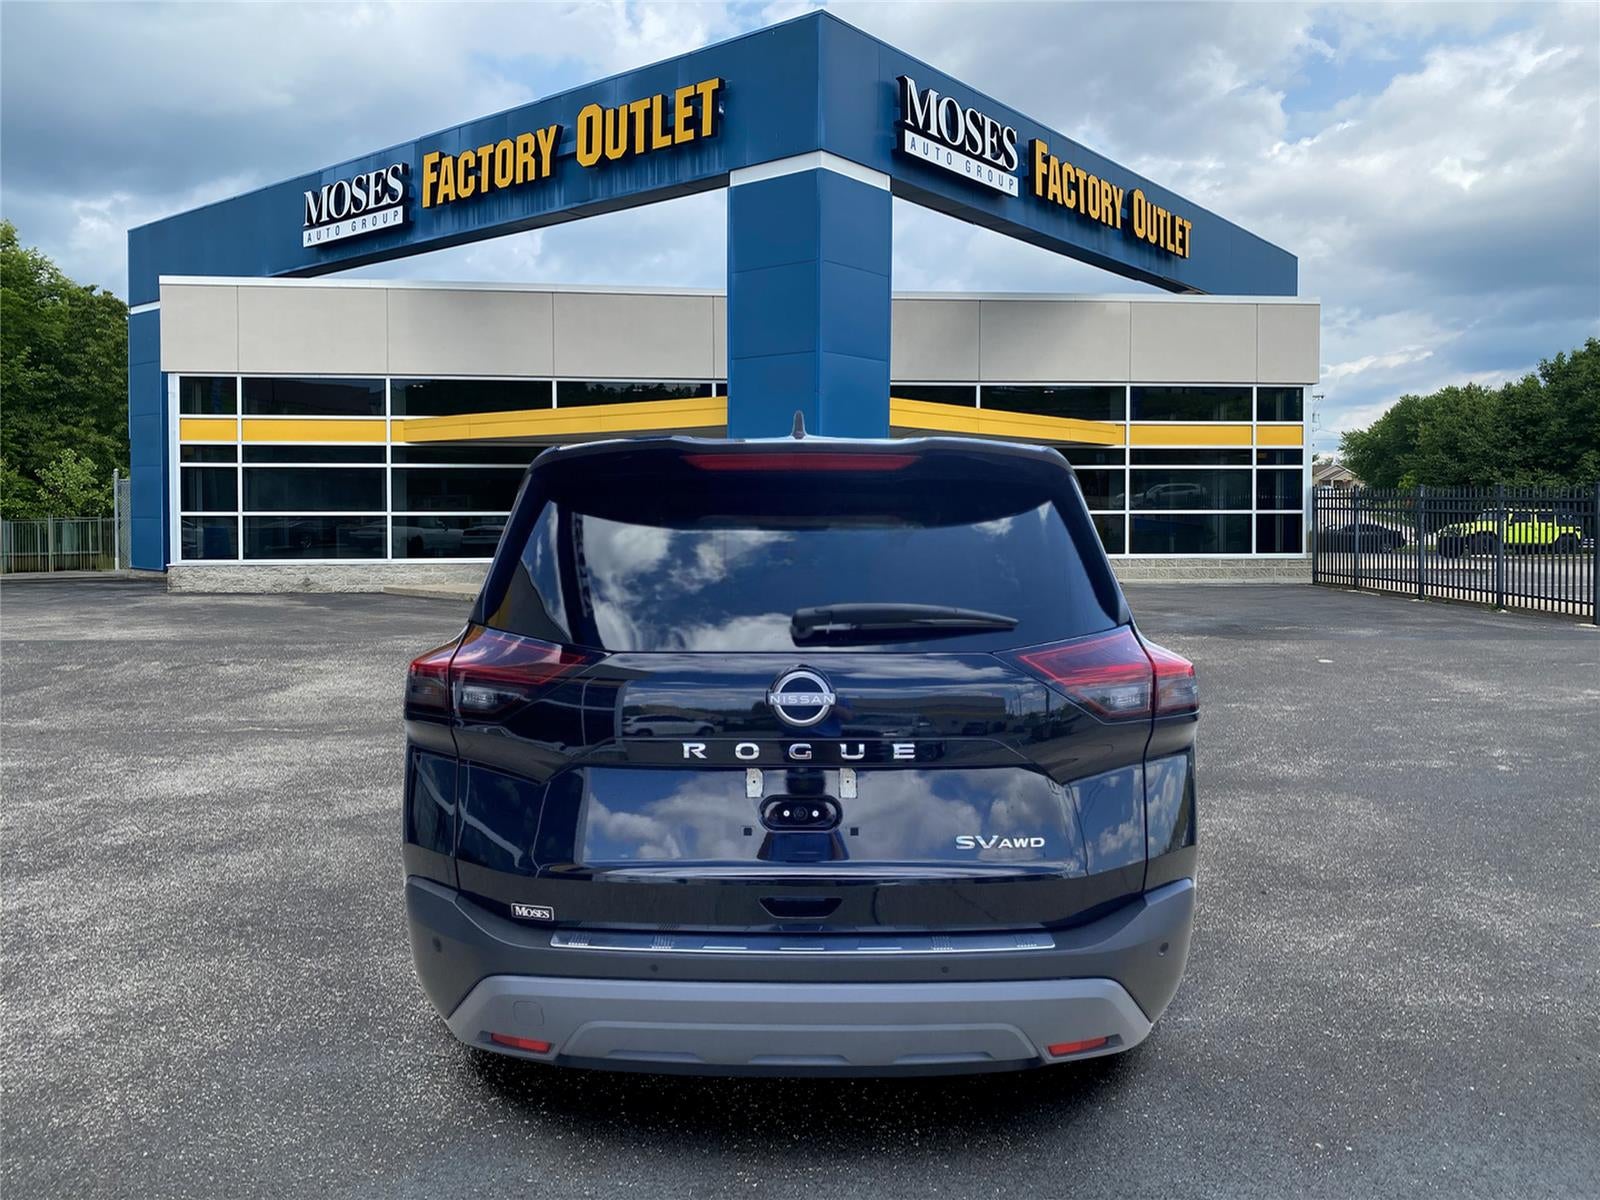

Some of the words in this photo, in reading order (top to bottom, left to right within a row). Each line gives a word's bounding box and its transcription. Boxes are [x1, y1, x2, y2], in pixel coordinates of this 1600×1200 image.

[422, 124, 560, 208] FACTORY
[576, 77, 721, 168] OUTLET
[904, 75, 1018, 172] MOSES
[909, 136, 953, 166] AUTO
[965, 158, 1014, 192] GROUP
[303, 163, 404, 227] MOSES
[1034, 138, 1124, 229] FACTORY
[1132, 188, 1193, 259] OUTLET
[307, 224, 340, 243] AUTO
[351, 210, 399, 232] GROUP
[769, 694, 834, 705] NISSAN
[682, 742, 917, 760] ROGUE
